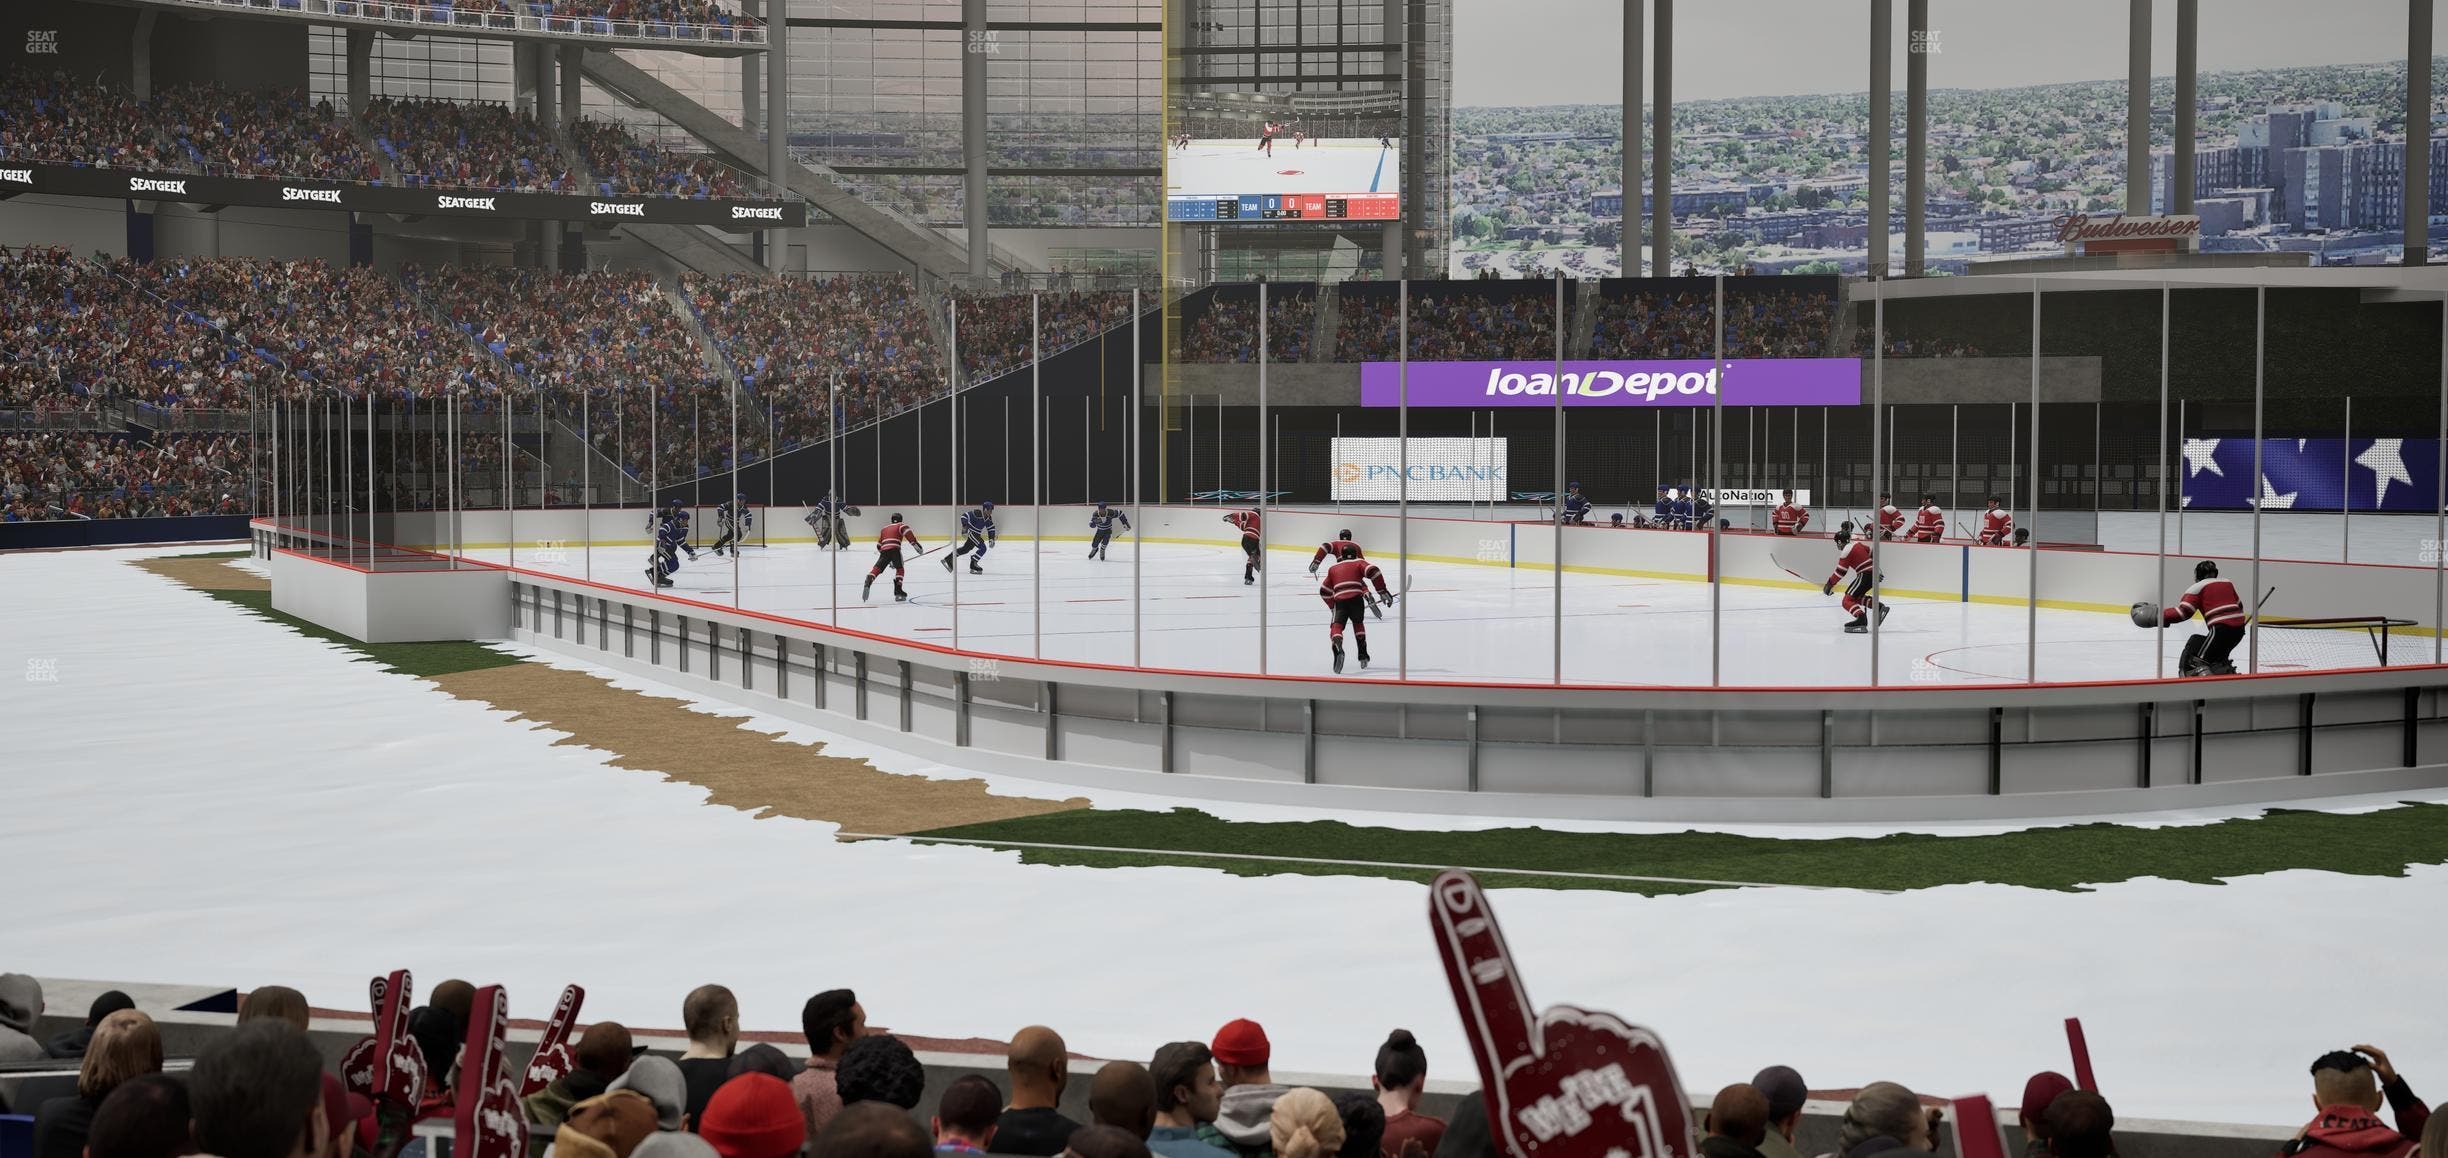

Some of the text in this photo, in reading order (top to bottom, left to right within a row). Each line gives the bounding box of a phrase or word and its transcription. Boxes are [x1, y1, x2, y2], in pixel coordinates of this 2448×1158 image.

[130, 177, 187, 194] SEATGEEK
[282, 187, 342, 203] SEATGEEK
[438, 195, 496, 211] SEATGEEK
[590, 201, 645, 216] SEATGEEK
[1241, 203, 1258, 211] TEAM
[1269, 198, 1275, 209] 0
[1289, 198, 1295, 209] 0
[1305, 203, 1322, 211] TEAM
[731, 206, 783, 220] SEATGEEK
[2054, 213, 2200, 242] Budweiser
[1486, 367, 1724, 402] loanDepot
[1367, 465, 1505, 481] PNC BANK
